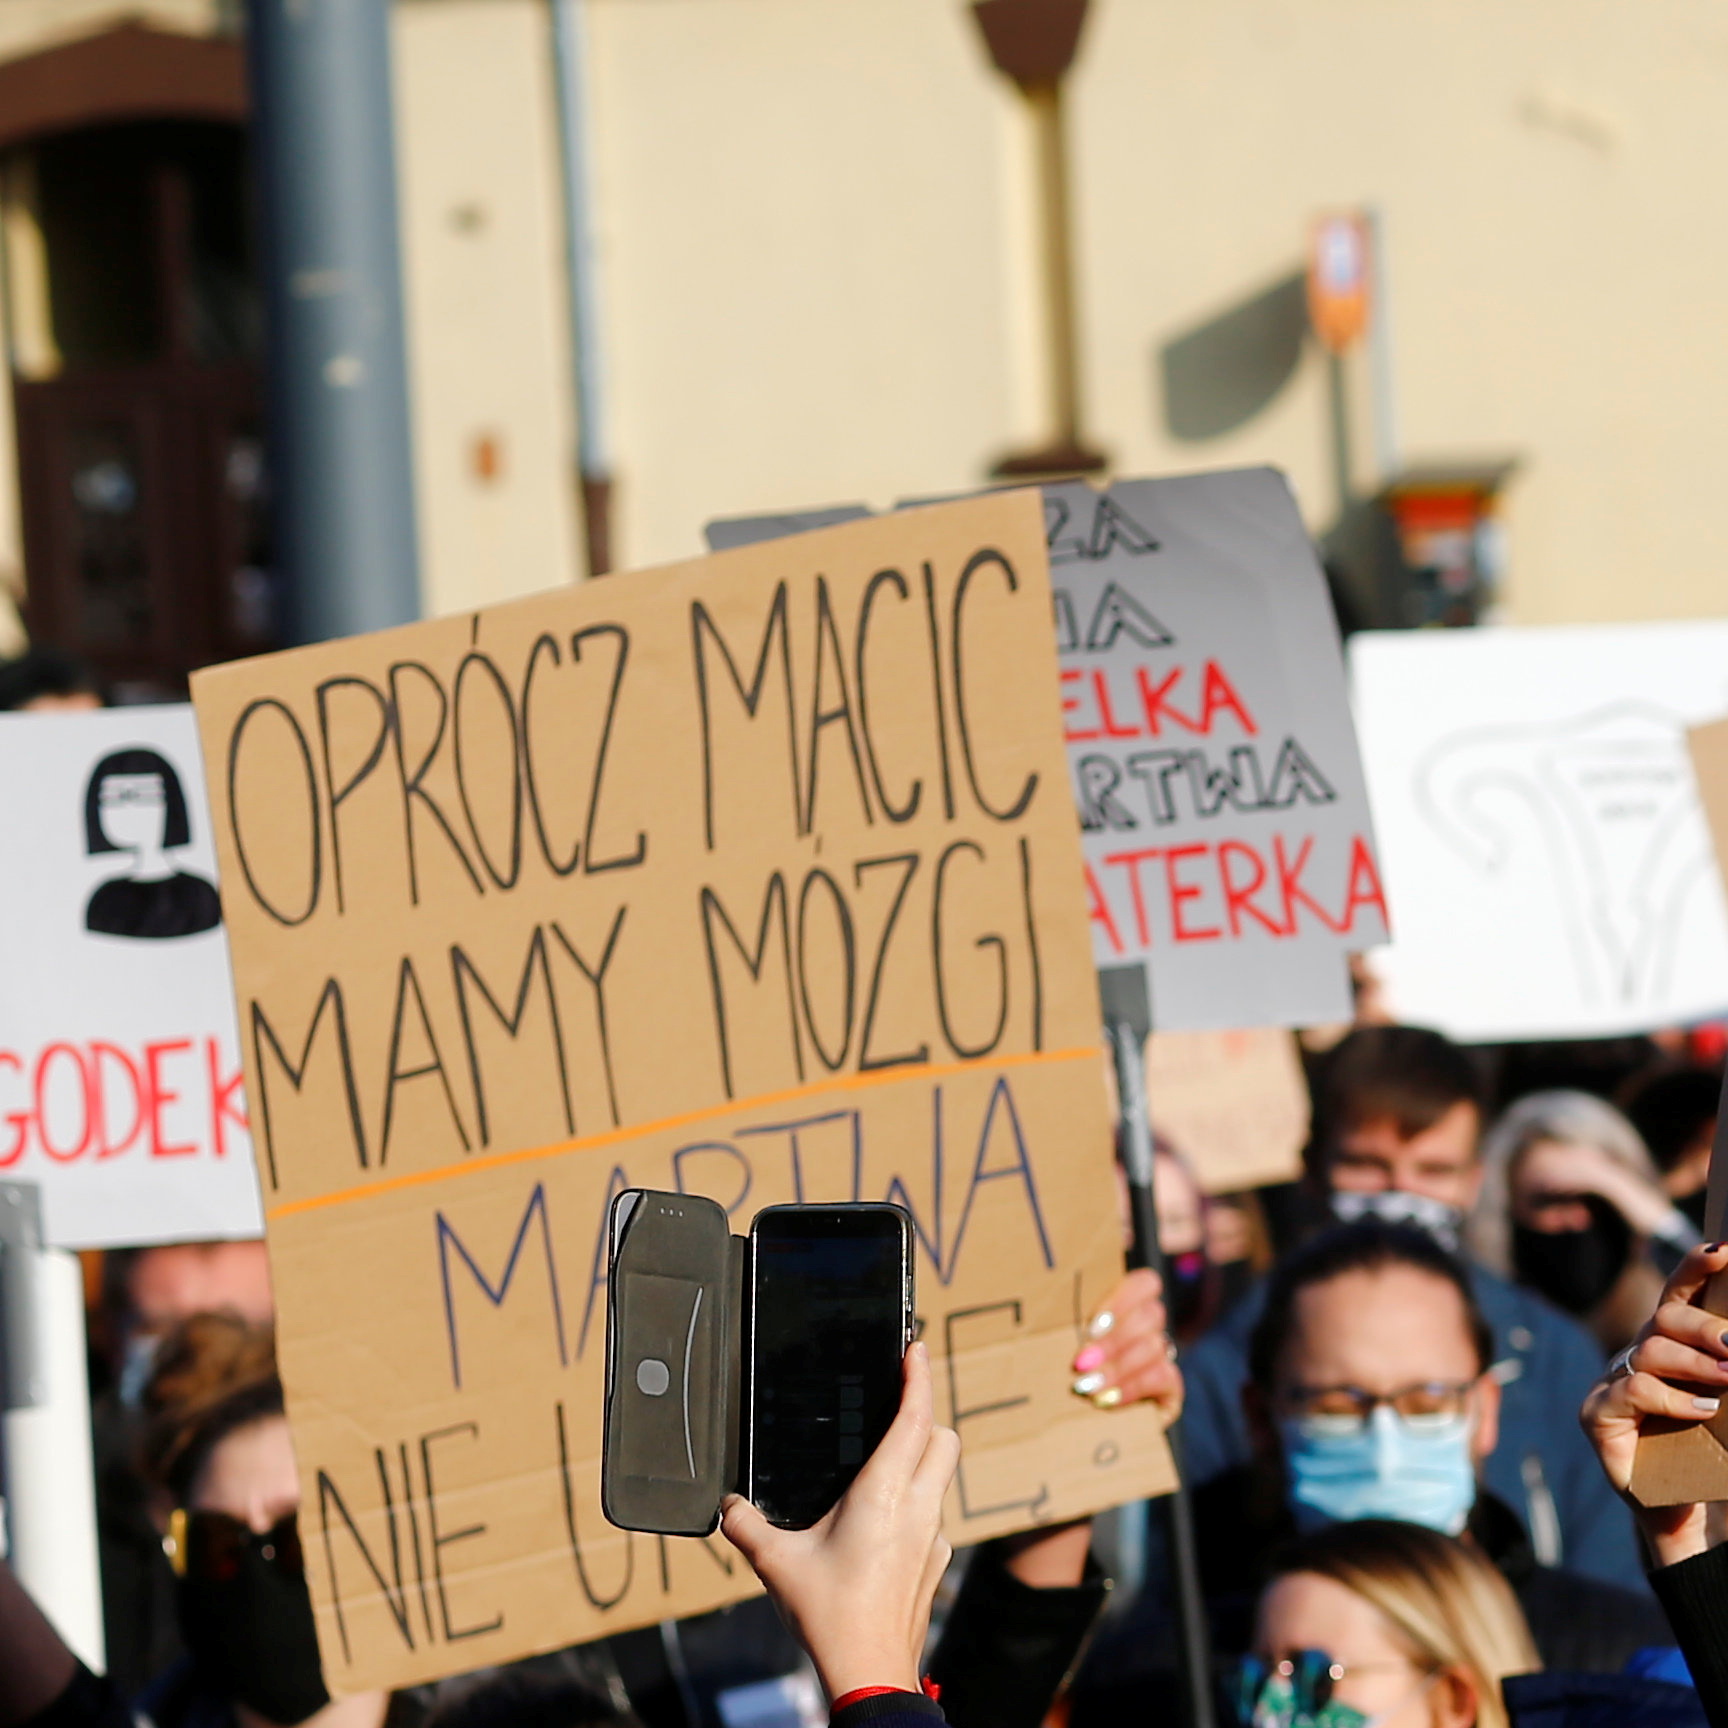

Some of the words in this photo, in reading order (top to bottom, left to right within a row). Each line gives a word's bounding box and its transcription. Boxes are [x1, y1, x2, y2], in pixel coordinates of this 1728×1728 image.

[226, 612, 648, 928] OPRÓCZ
[690, 546, 1041, 853] MACIC
[1060, 657, 1260, 743] ELKA
[249, 902, 630, 1192] MAMY
[699, 836, 1047, 1101] MÓZGI
[315, 1420, 505, 1665] NIE
